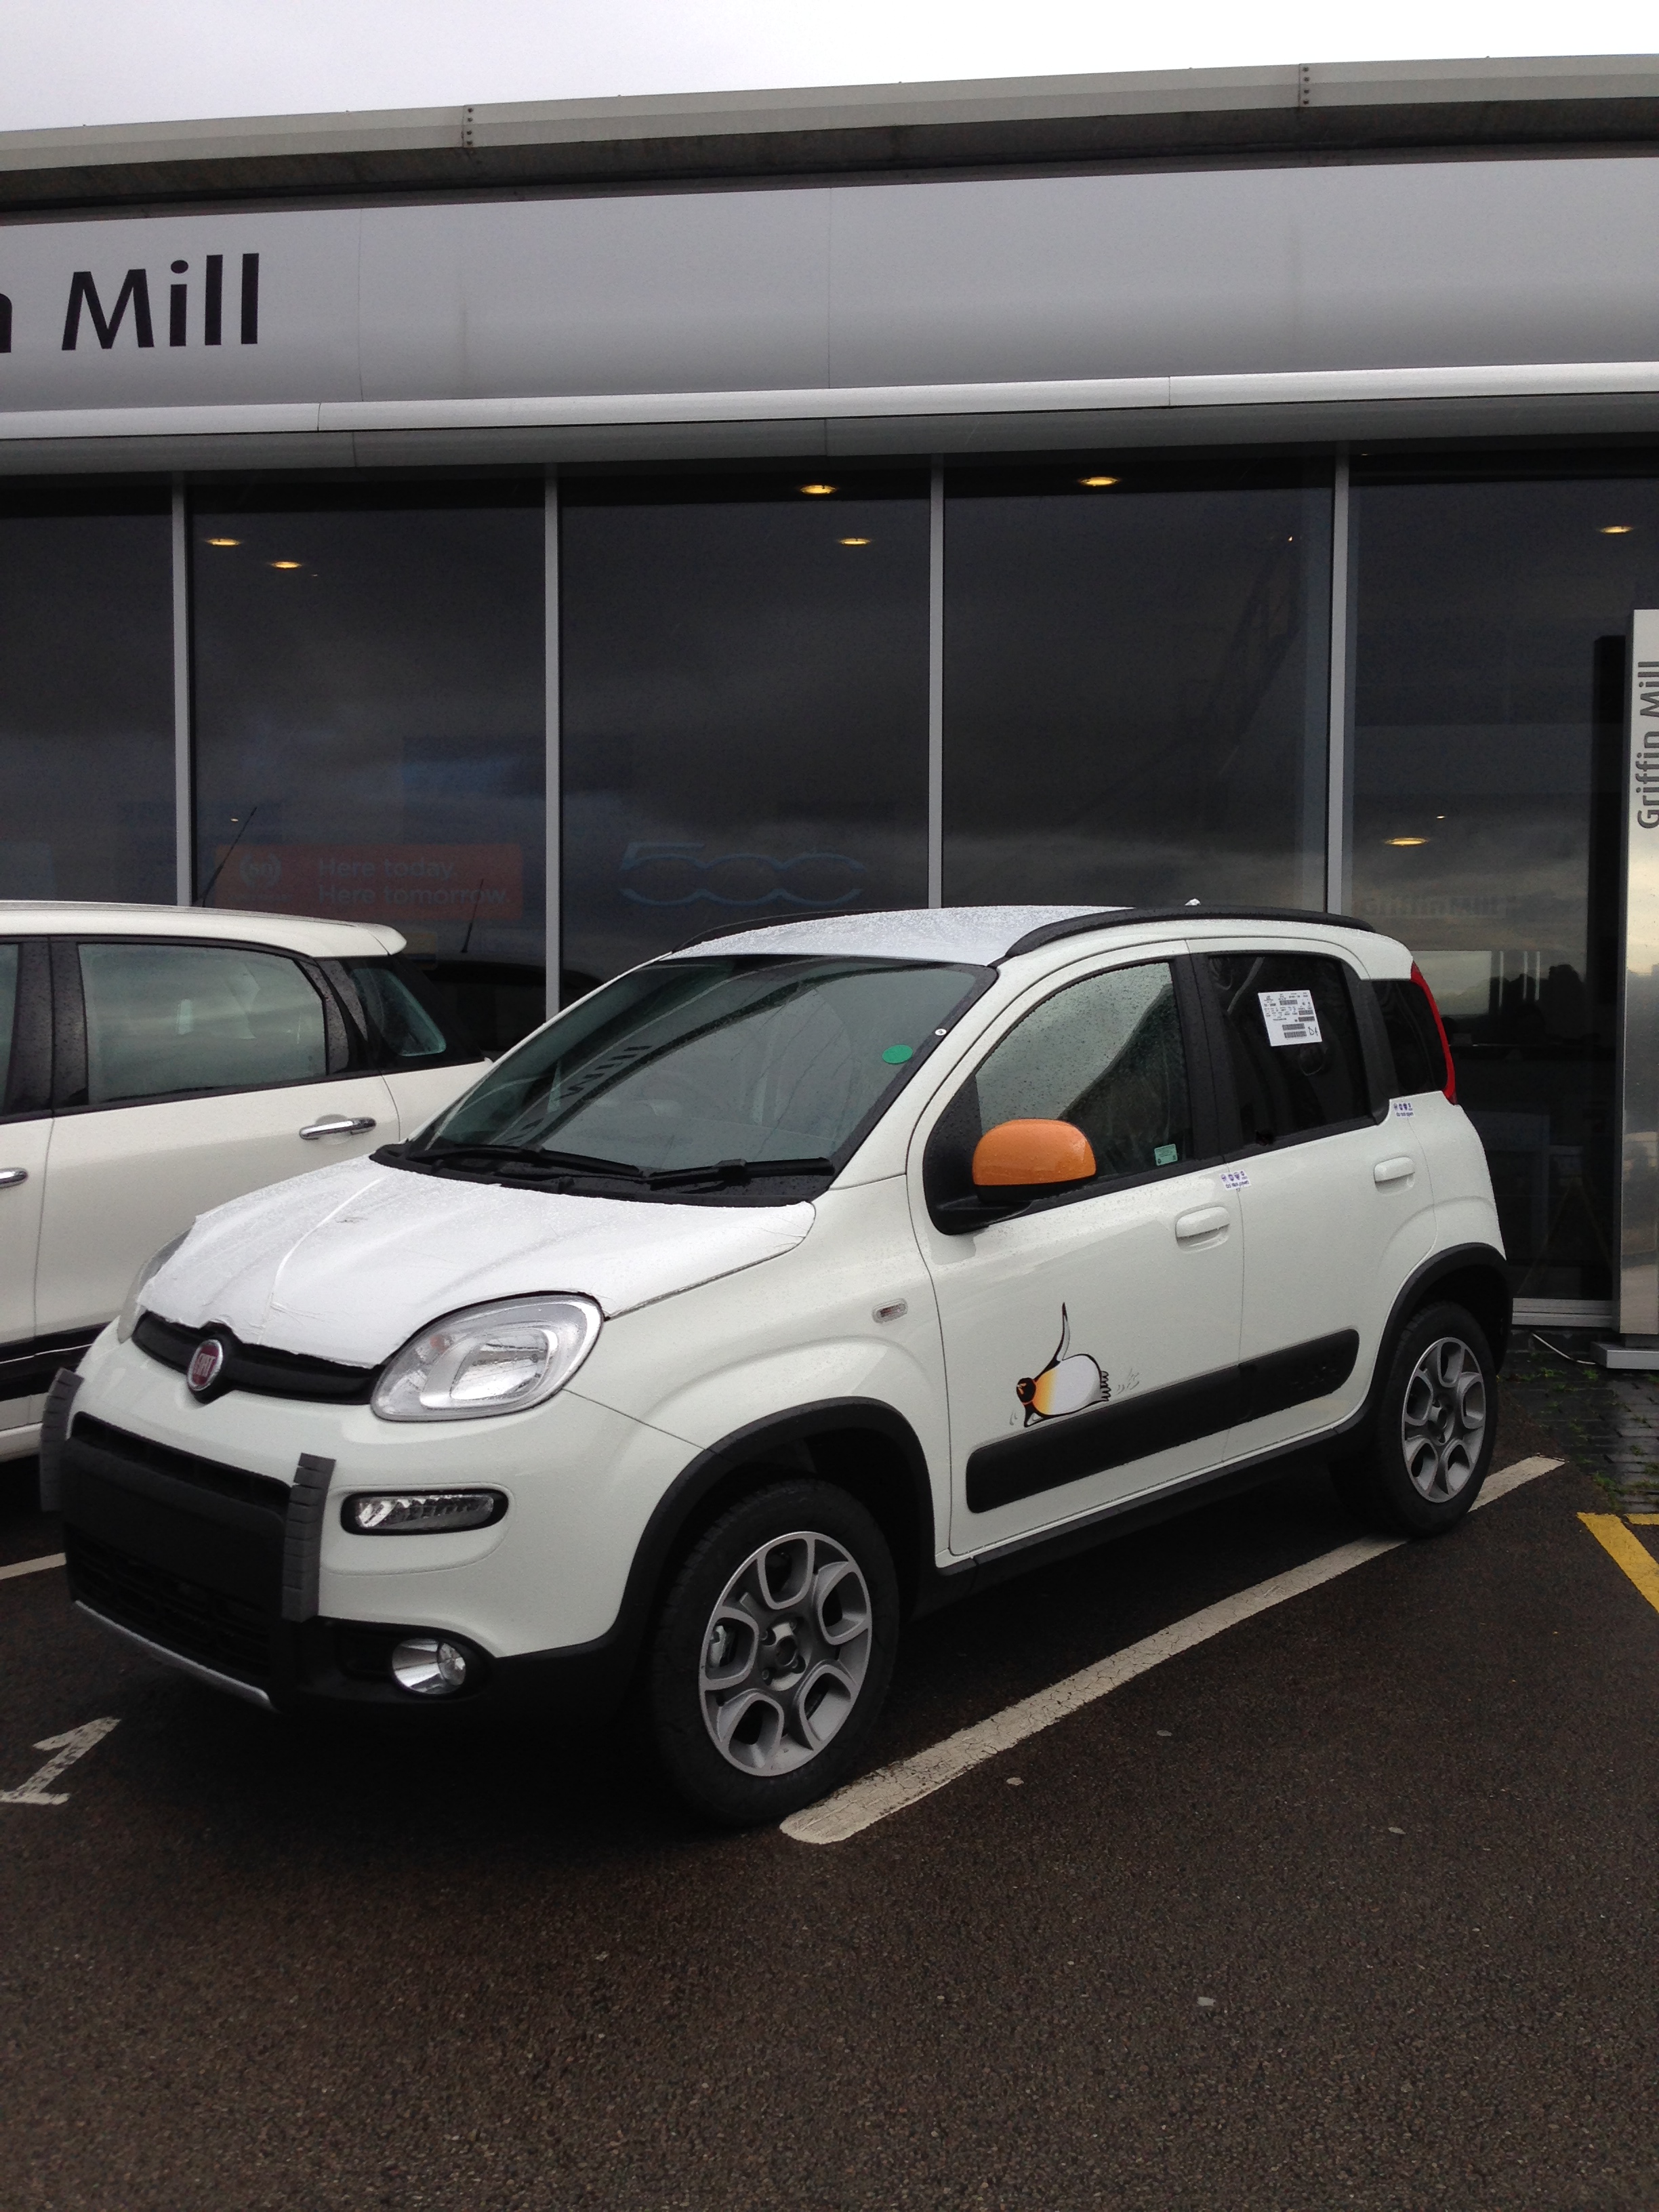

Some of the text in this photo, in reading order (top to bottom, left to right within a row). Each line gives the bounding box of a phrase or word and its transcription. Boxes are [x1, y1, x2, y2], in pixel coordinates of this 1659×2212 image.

[62, 253, 259, 350] Mill
[1635, 661, 1659, 830] Griffin Mill
[319, 857, 375, 878] Here
[319, 884, 375, 905] Here
